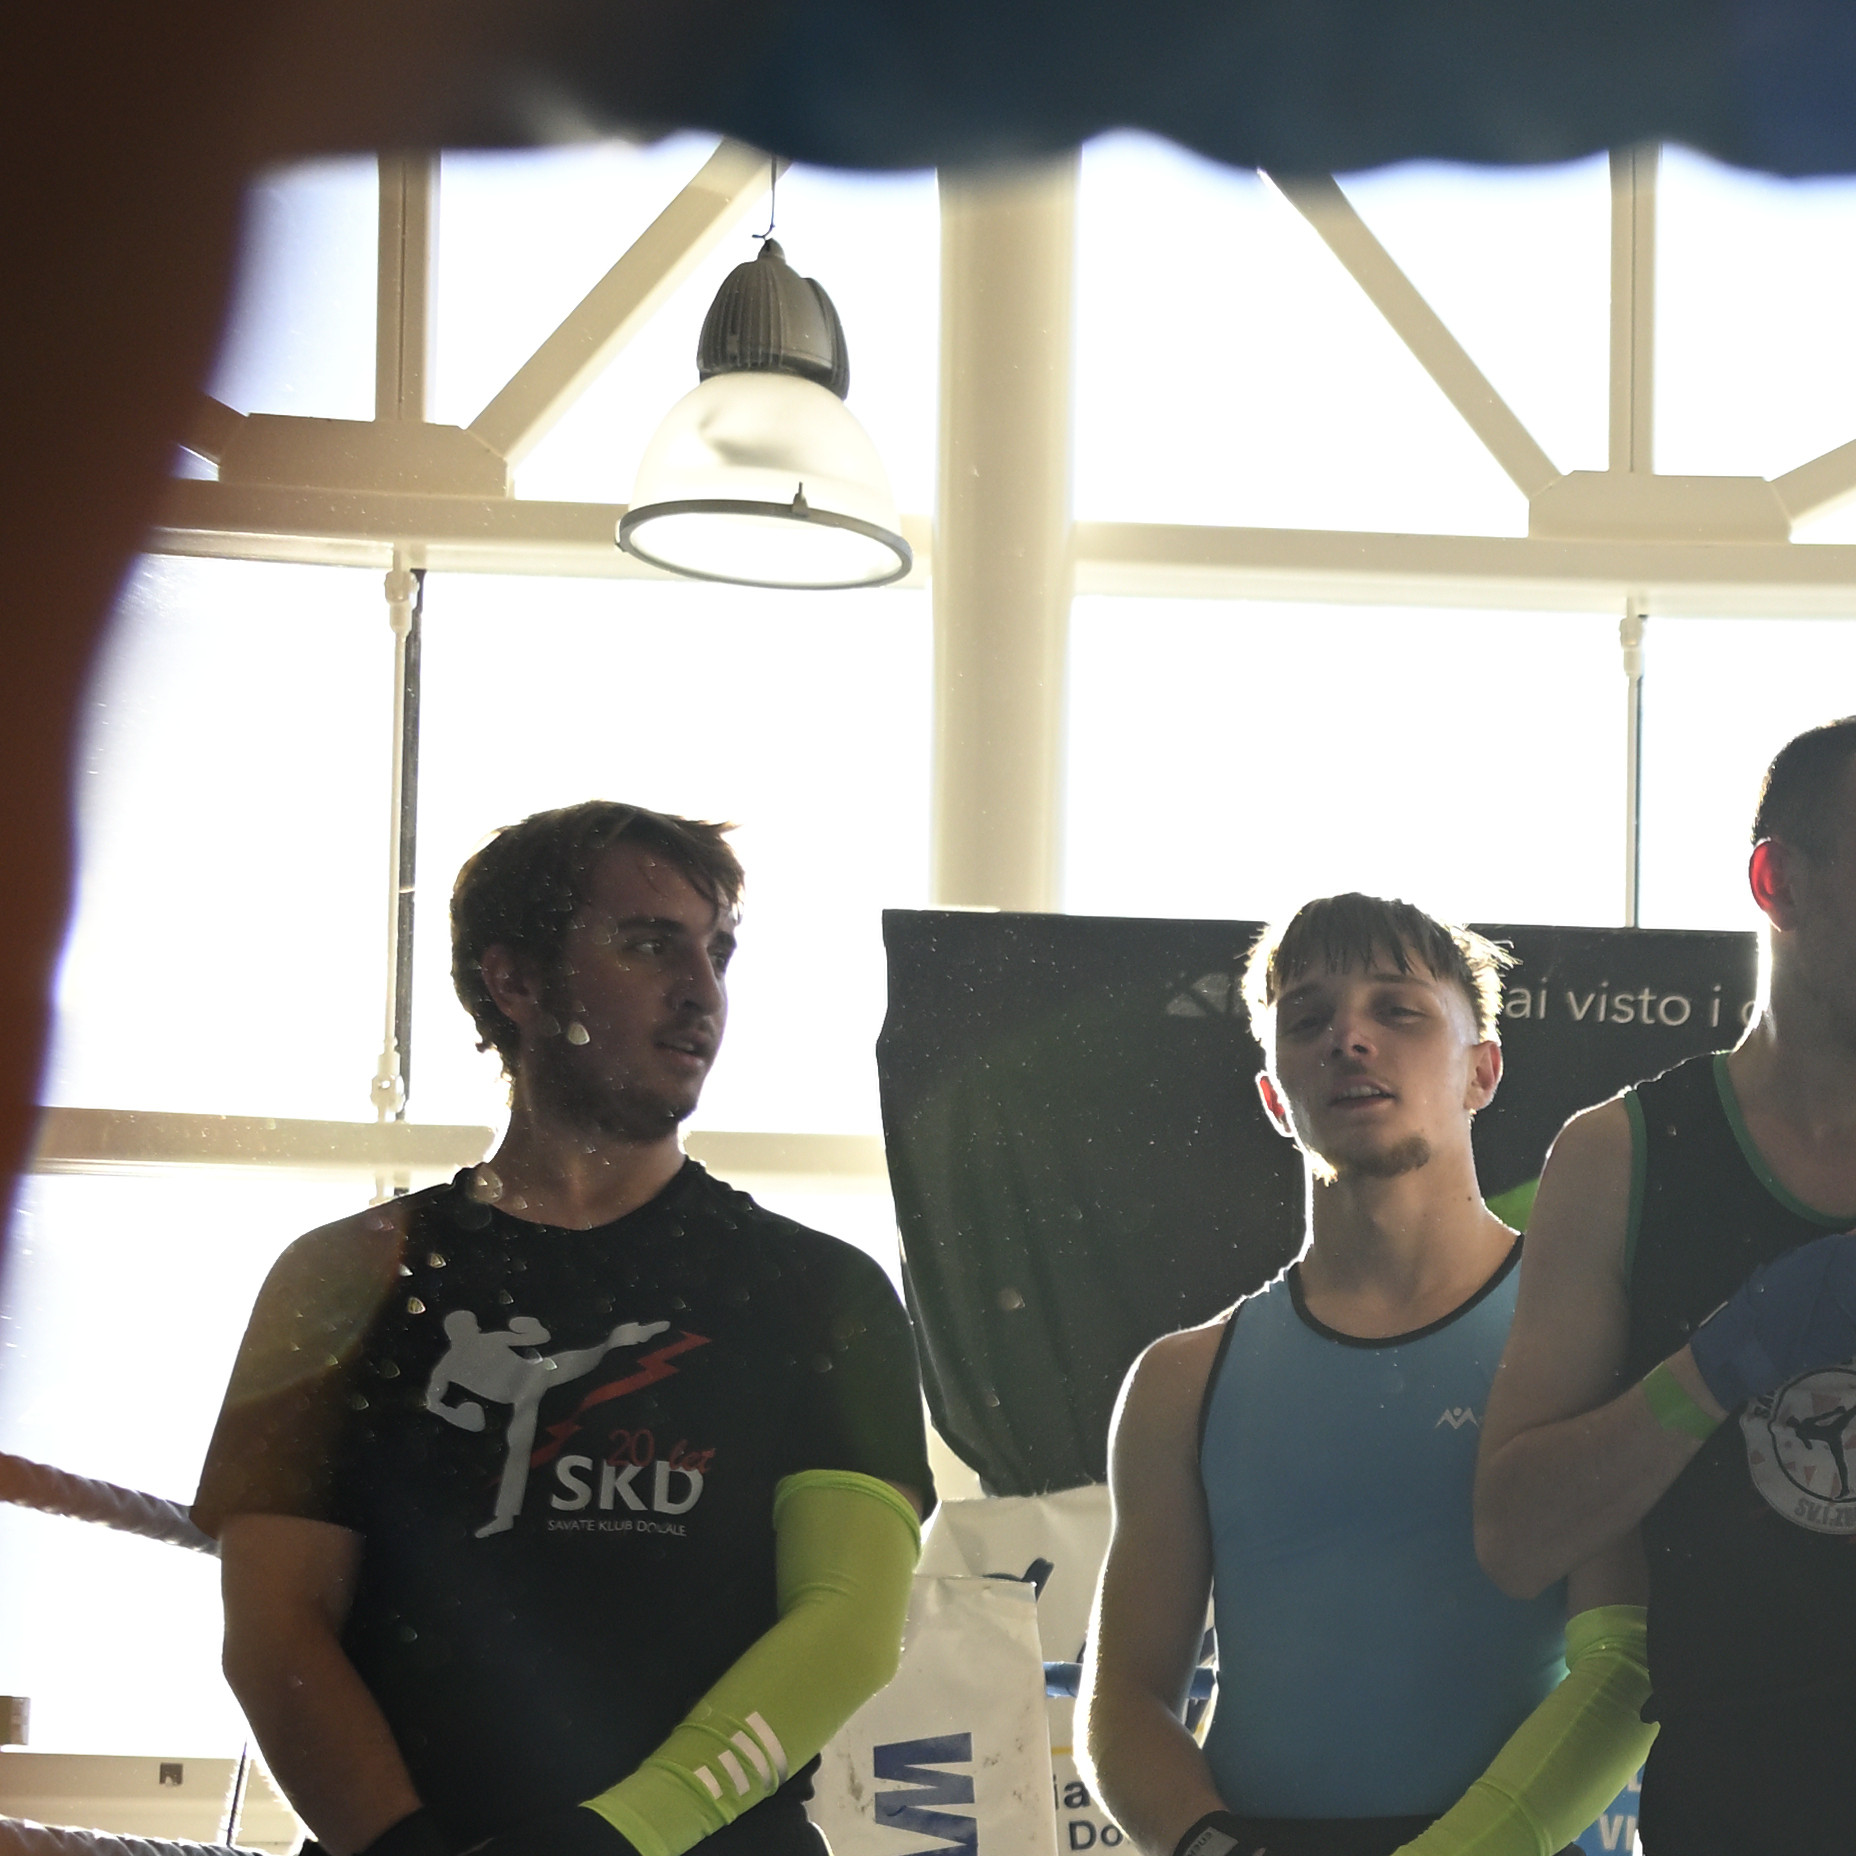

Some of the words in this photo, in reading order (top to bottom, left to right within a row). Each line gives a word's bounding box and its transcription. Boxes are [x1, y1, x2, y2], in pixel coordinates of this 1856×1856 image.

[1566, 978, 1692, 1027] visto
[1711, 983, 1722, 1028] i
[606, 1427, 656, 1468] 20
[549, 1453, 705, 1516] SKD
[547, 1518, 597, 1533] SAVATE
[597, 1519, 634, 1533] KLUB
